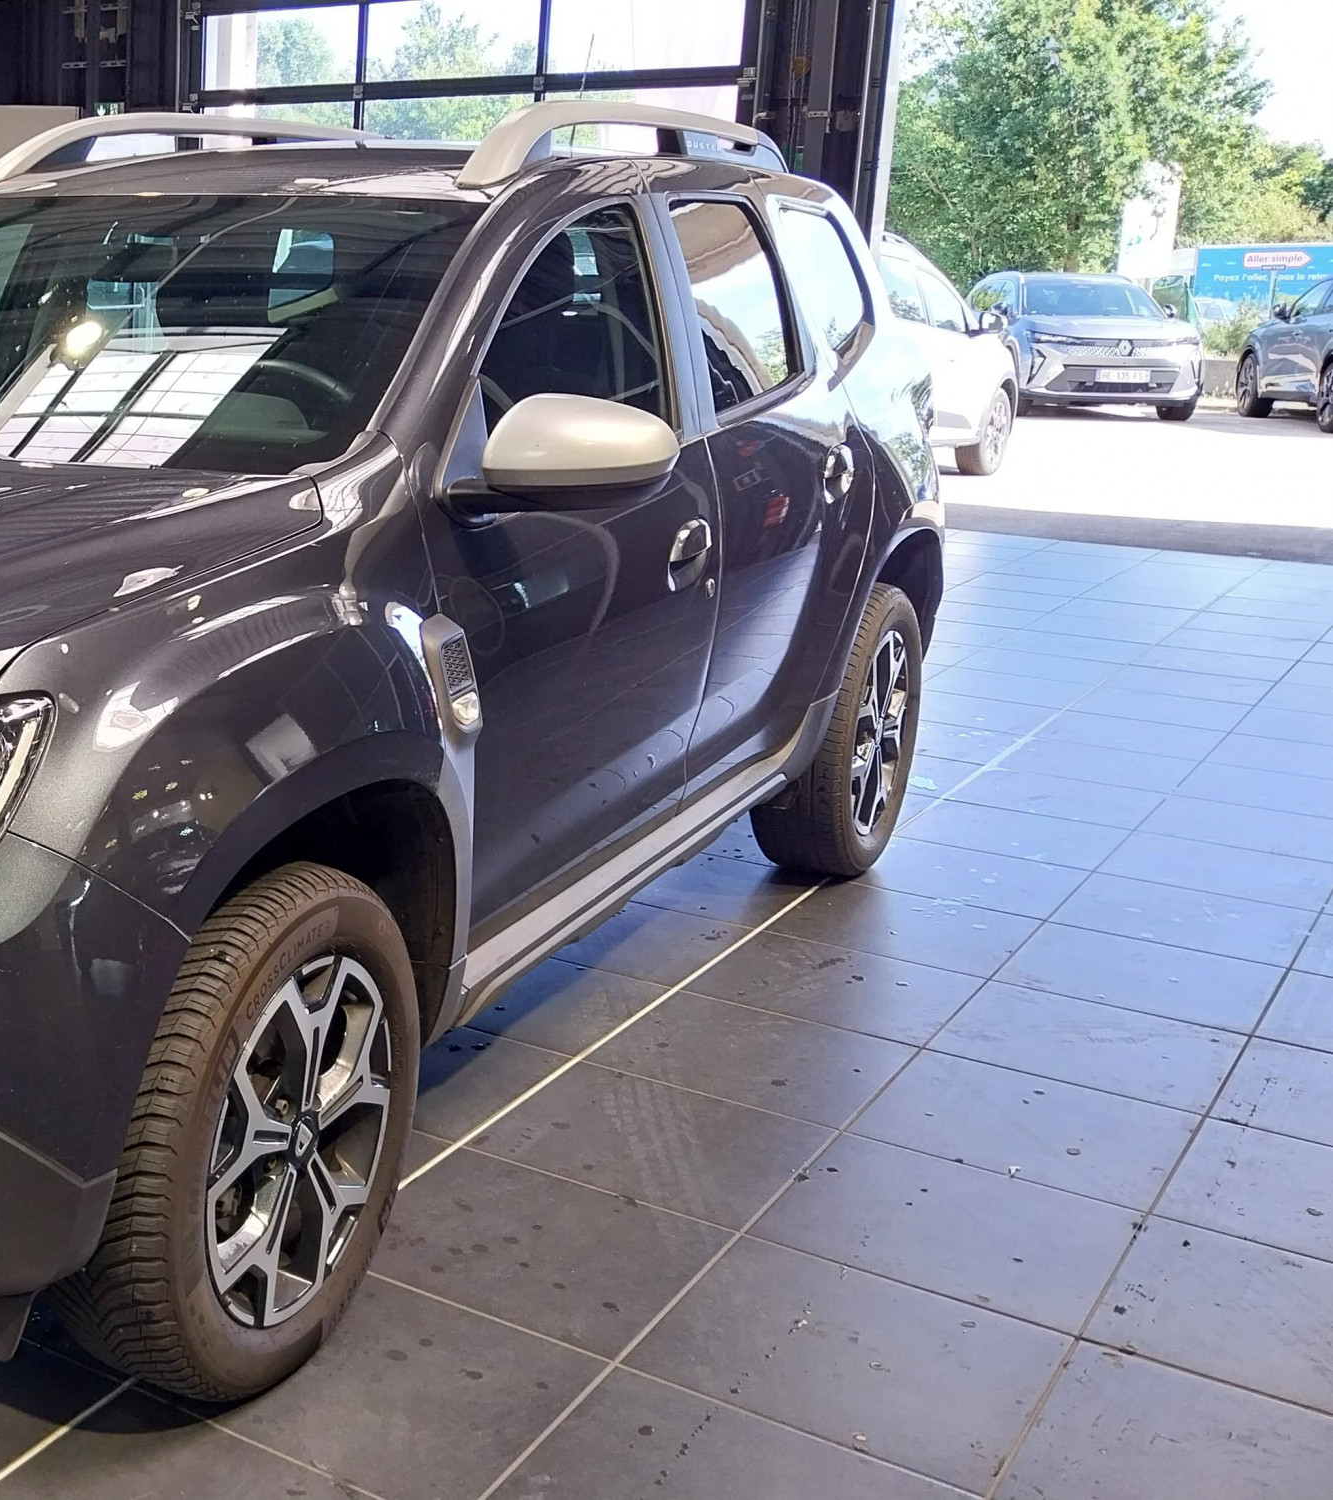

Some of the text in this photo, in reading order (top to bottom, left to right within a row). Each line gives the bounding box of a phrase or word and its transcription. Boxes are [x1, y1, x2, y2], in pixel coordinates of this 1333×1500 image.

[1246, 253, 1303, 264] Aller simple
[1213, 273, 1240, 283] Payez
[1278, 274, 1295, 283] pas
[1296, 272, 1306, 281] le
